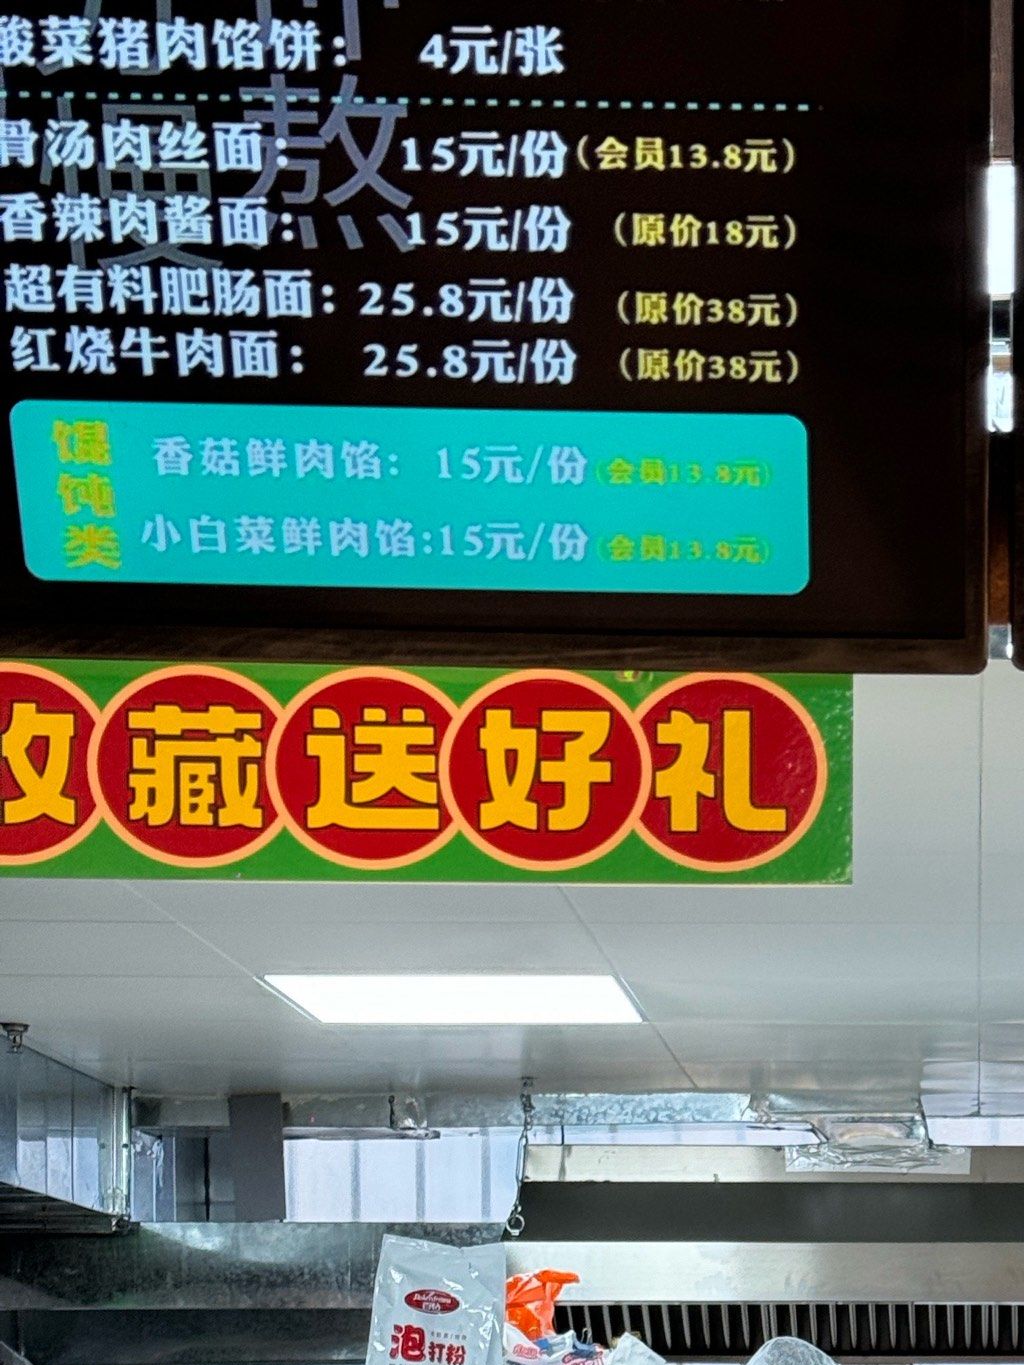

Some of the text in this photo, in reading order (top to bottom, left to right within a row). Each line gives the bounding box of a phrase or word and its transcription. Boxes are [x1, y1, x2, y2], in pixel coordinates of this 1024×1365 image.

[418, 25, 565, 75] 4元/张
[402, 129, 566, 178] 15元/份
[0, 192, 295, 247] 香辣肉酱面：
[405, 205, 572, 253] 15元/份
[3, 263, 337, 318] 超有料肥肠面：
[358, 276, 573, 326] 25.8元/份
[11, 325, 306, 378] 红烧牛肉面：
[363, 340, 577, 386] 25.8元/份
[436, 445, 587, 486] 15元/份
[52, 419, 122, 569] 馄饨类
[389, 1324, 466, 1365] 泡打粉
